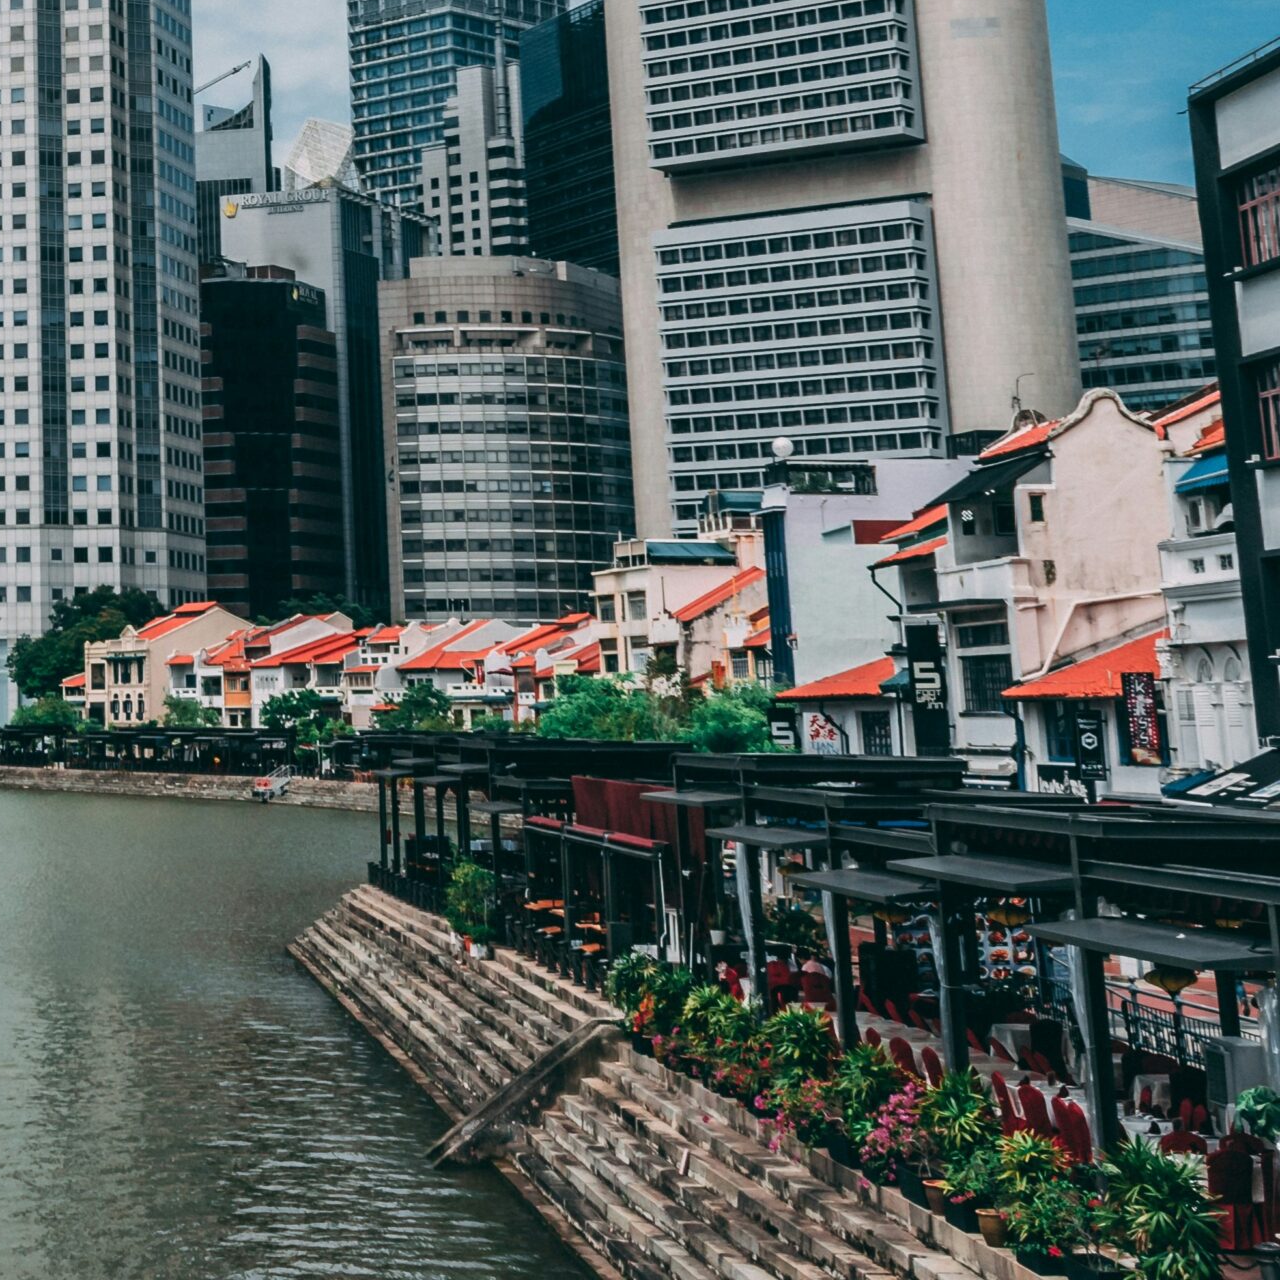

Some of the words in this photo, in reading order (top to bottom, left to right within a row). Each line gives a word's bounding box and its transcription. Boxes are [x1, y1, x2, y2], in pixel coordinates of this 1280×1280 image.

[286, 188, 330, 205] GROUP
[913, 661, 941, 689] 5
[771, 721, 795, 745] 5
